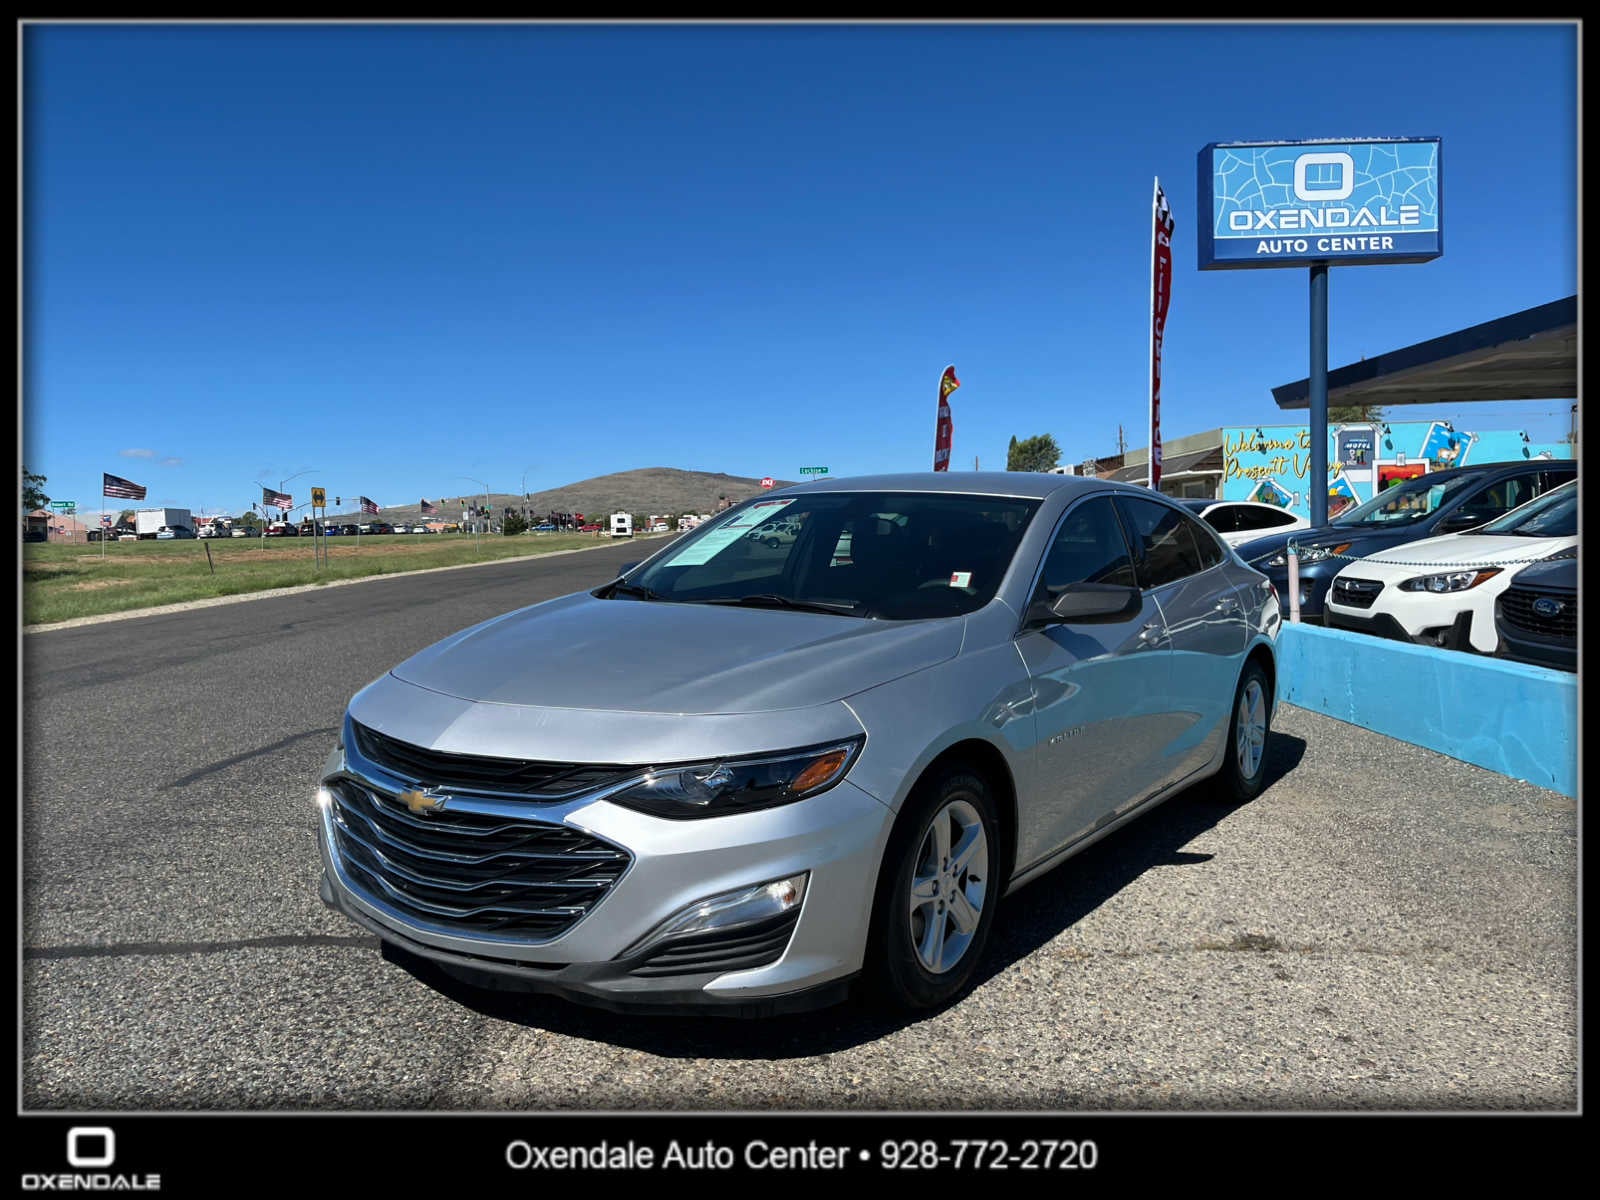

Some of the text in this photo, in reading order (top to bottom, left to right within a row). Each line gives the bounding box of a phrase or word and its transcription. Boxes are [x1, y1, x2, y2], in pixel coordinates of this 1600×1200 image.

[1229, 204, 1420, 231] OXENDALE
[1256, 236, 1393, 254] AUTO CENTER
[1224, 430, 1294, 457] Welcome
[1224, 457, 1289, 482] Prescott
